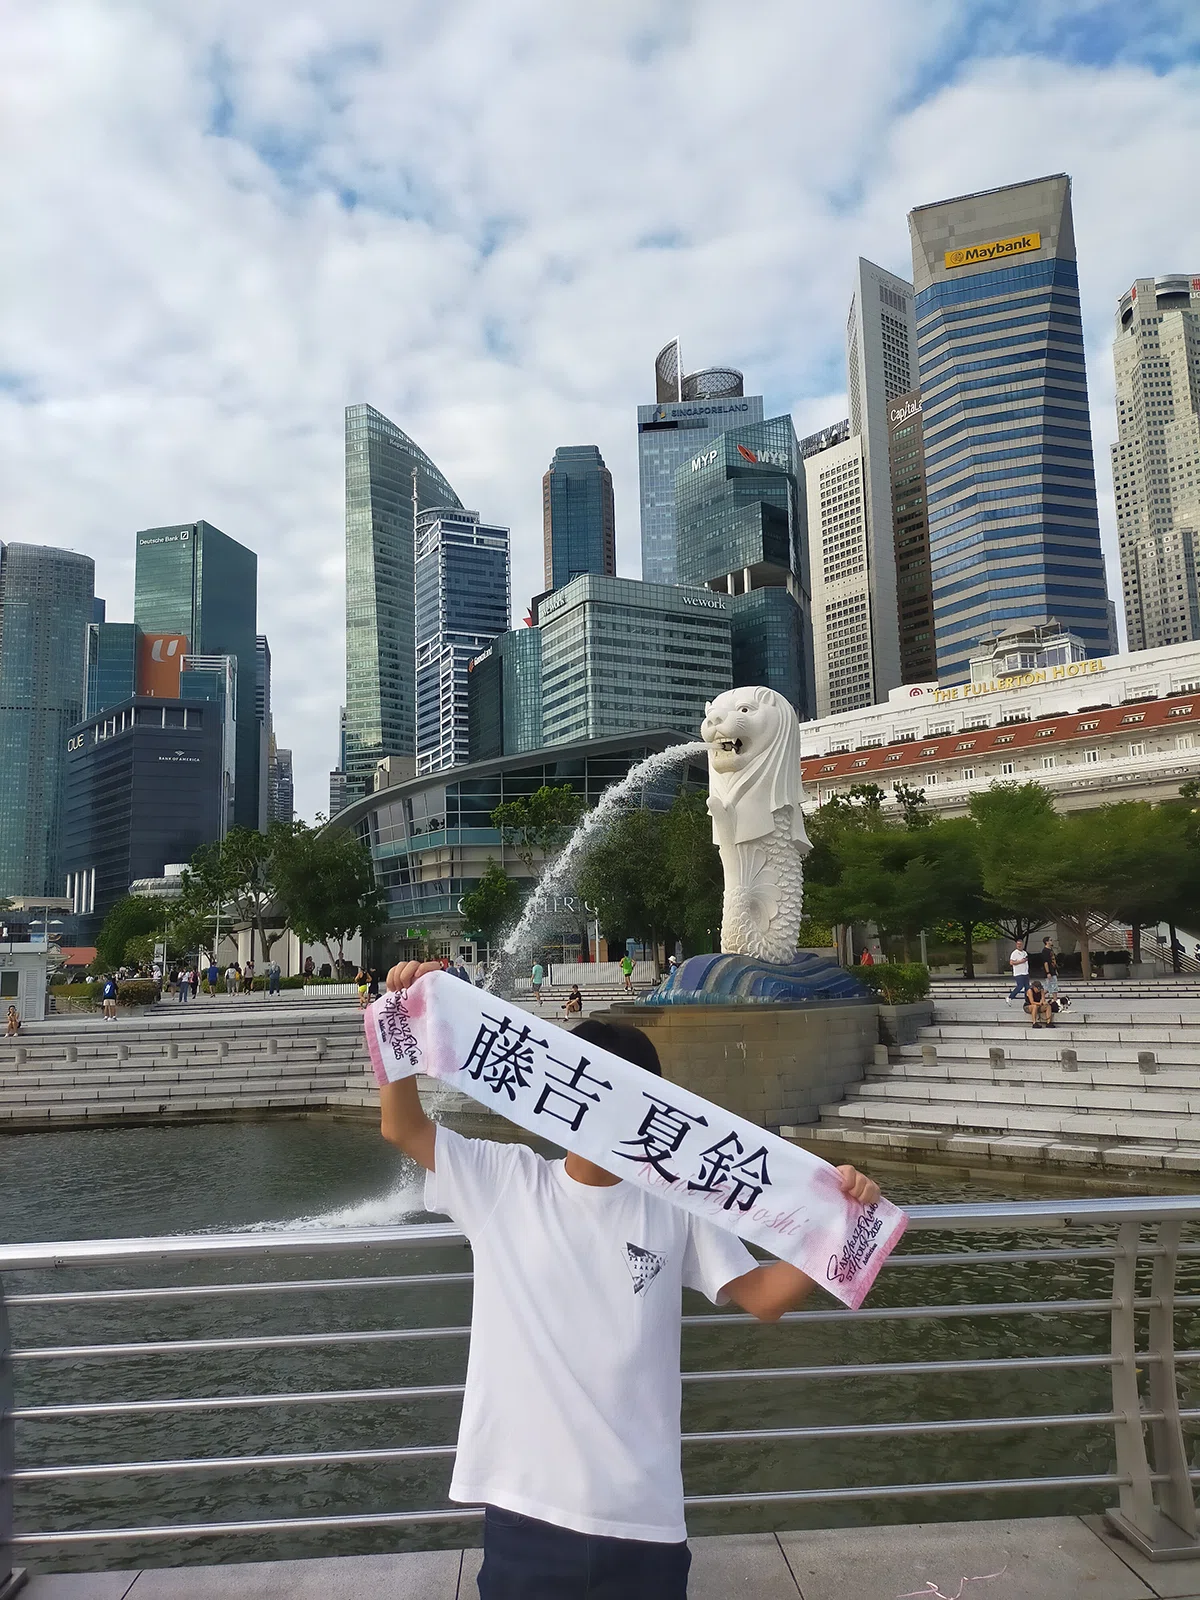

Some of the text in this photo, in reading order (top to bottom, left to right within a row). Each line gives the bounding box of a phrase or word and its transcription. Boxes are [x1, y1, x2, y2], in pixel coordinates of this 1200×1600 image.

[965, 238, 1031, 260] Maybank
[671, 404, 748, 418] SINGAPORELAND
[691, 450, 718, 472] MYP
[757, 450, 788, 466] MYP
[140, 537, 164, 545] Deutsche
[683, 597, 726, 609] wework
[933, 659, 1106, 702] THE FULLERTON HOTEL
[67, 733, 84, 752] OUE
[391, 1039, 405, 1060] 2025
[459, 1012, 772, 1211] 藤吉 夏鈴
[867, 1218, 883, 1238] 2025
[863, 1243, 878, 1265] Addiction
